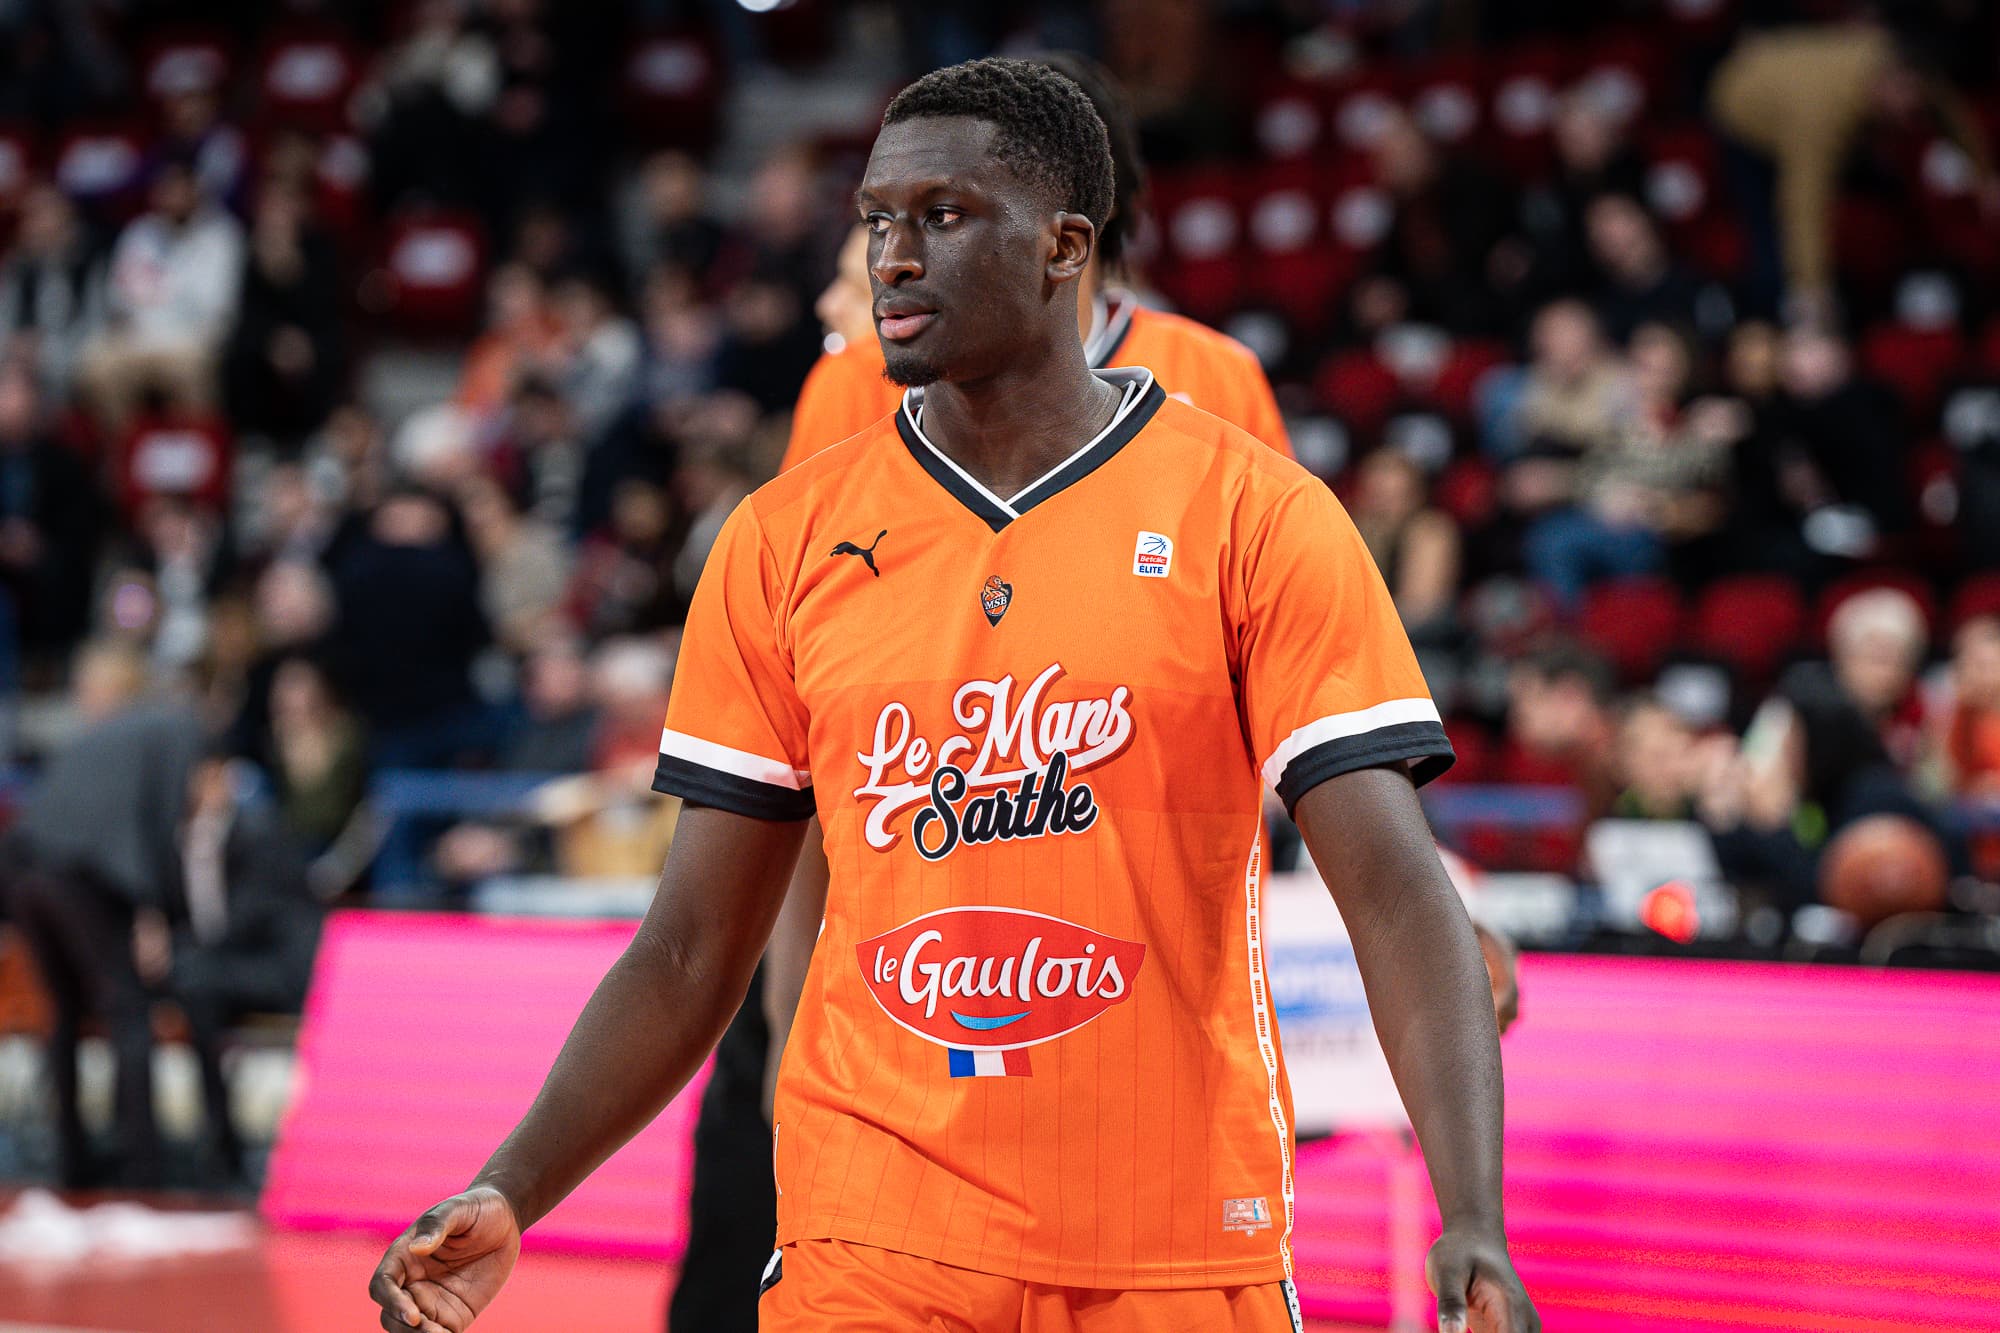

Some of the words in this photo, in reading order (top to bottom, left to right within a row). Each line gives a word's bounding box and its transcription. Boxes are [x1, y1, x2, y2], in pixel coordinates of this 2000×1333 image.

[985, 596, 1007, 610] MSB
[853, 701, 932, 851] Le
[937, 661, 1135, 788] Mans
[911, 750, 1099, 862] Sarthe
[1249, 852, 1260, 877] PUMA
[874, 945, 898, 984] le
[899, 929, 1126, 1019] Gaulois
[1251, 947, 1260, 974] PUMA
[1254, 979, 1263, 1006] PUMA
[1257, 1012, 1267, 1038] PUMA
